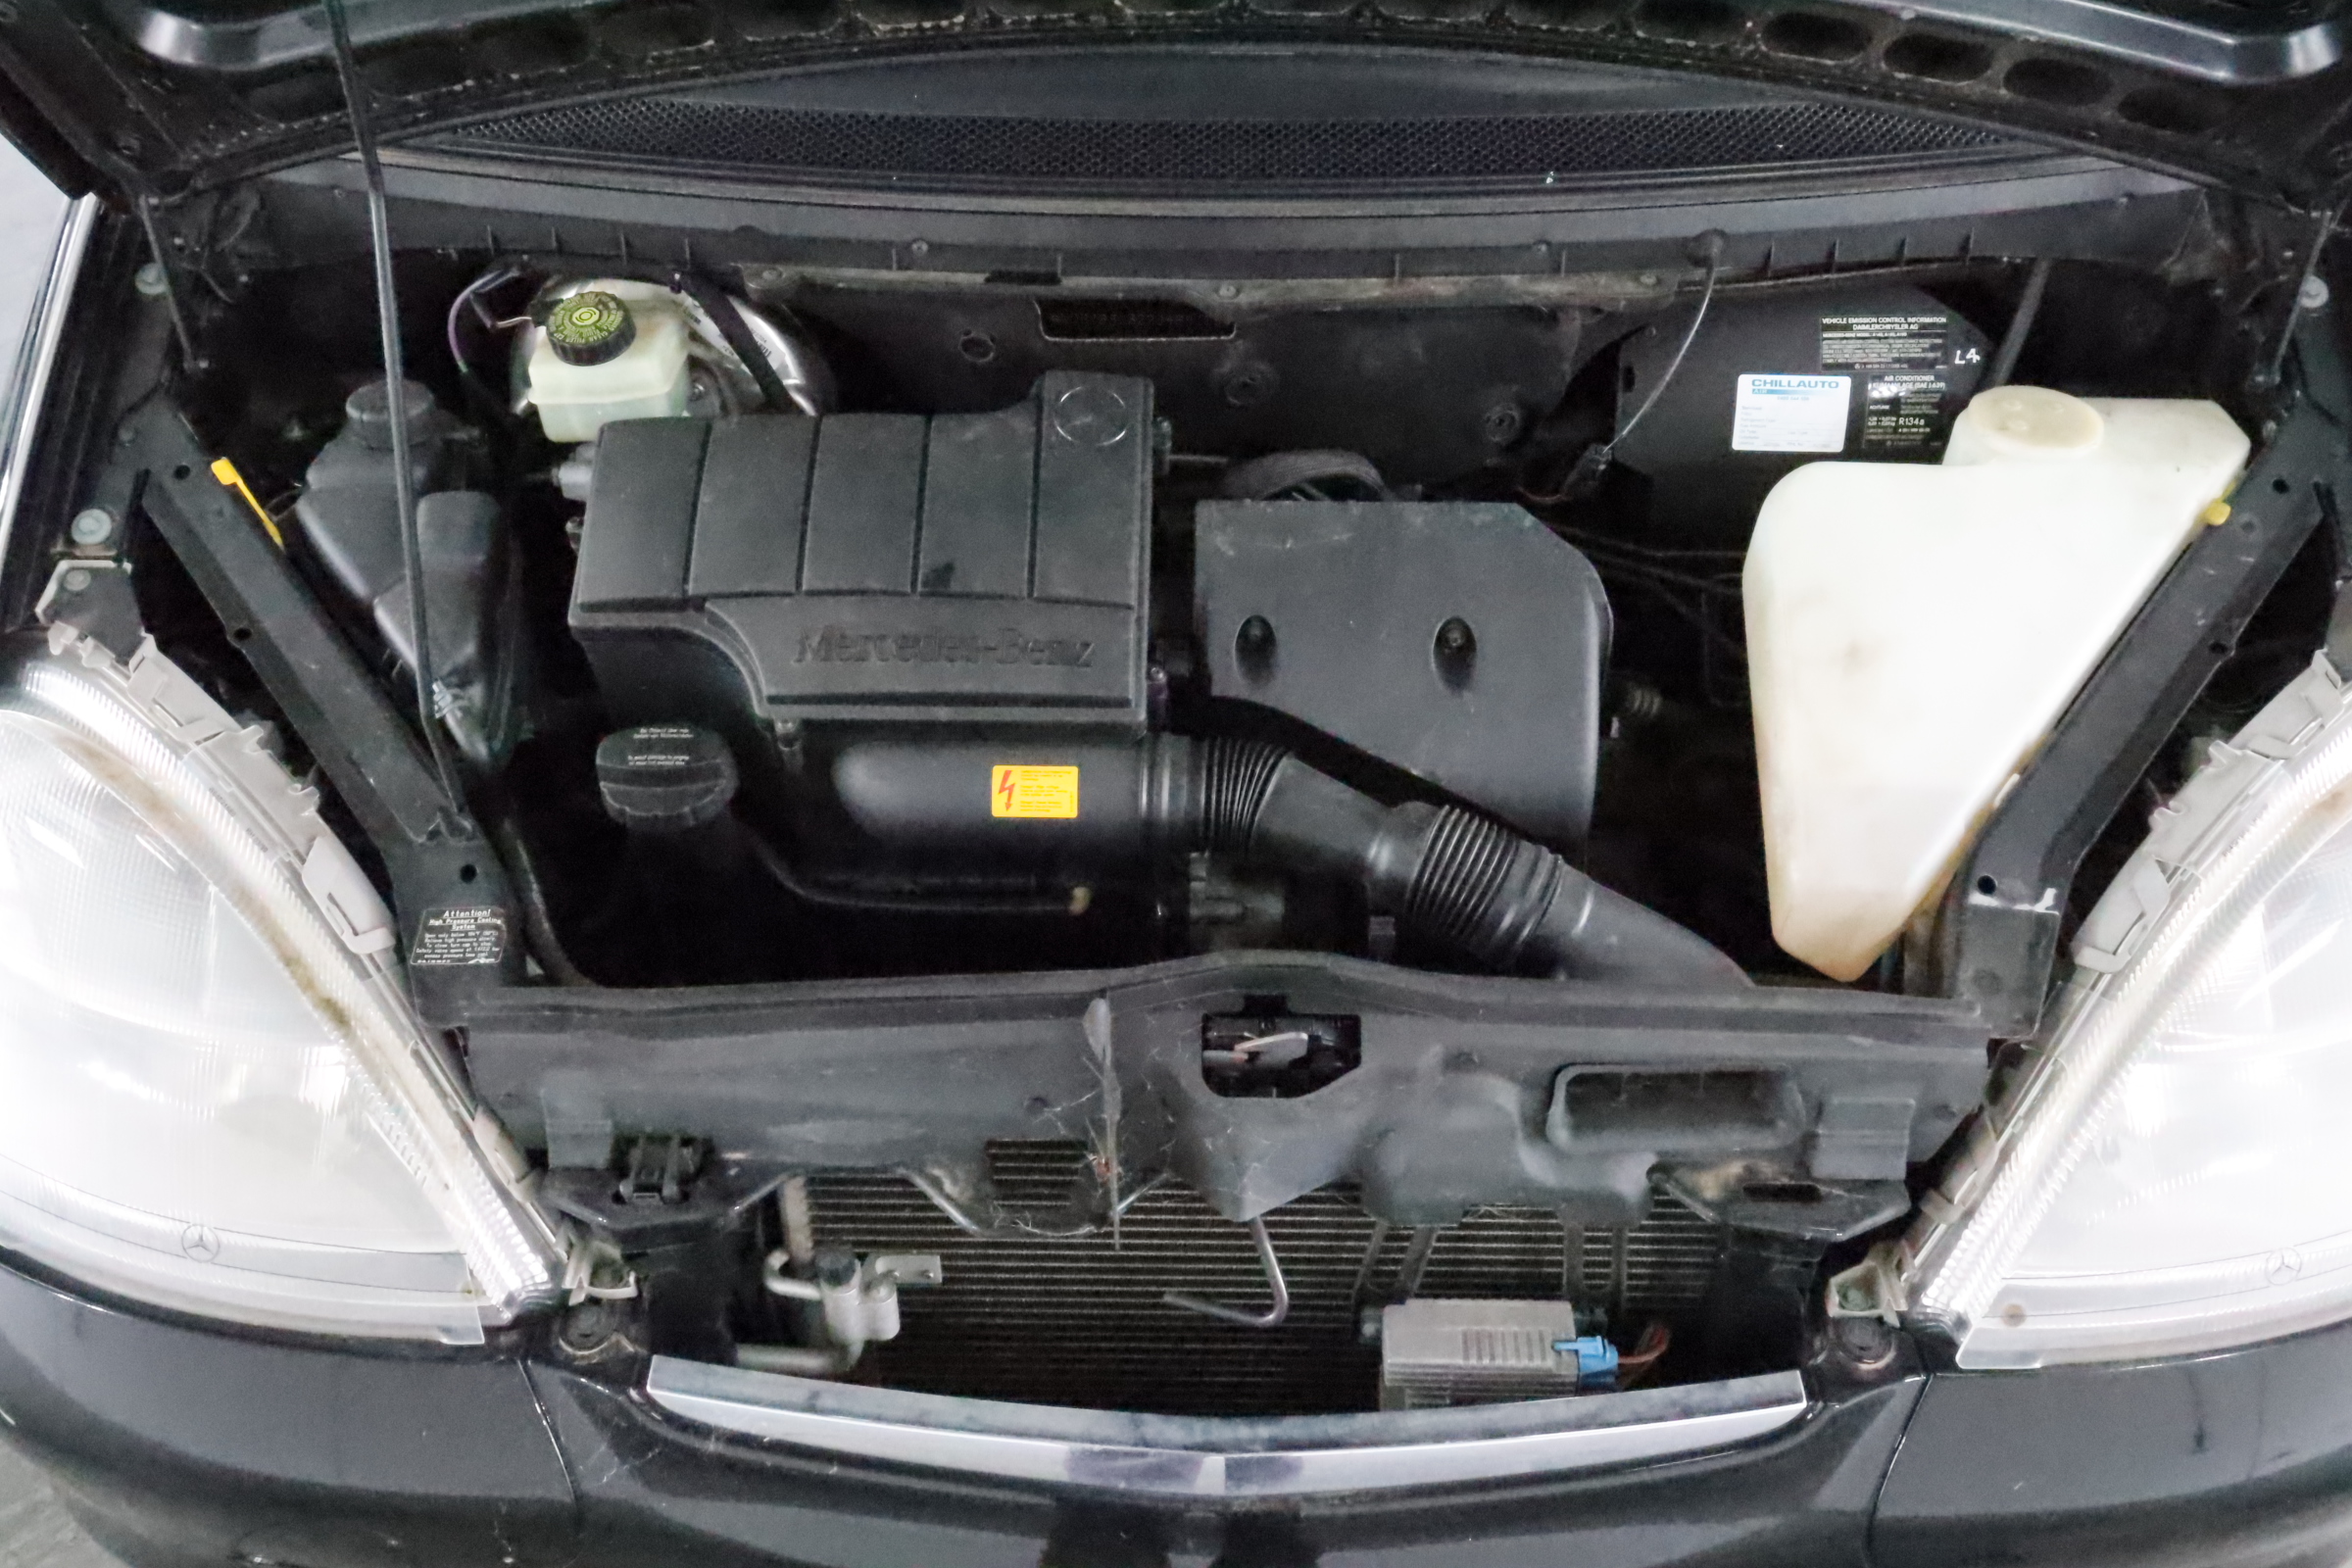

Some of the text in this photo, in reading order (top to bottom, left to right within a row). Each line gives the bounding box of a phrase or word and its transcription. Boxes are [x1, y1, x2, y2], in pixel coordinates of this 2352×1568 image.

[1751, 378, 1839, 389] CHILLAUTO
[791, 624, 1095, 667] Mercedes-Benz
[443, 908, 491, 918] Attention!
